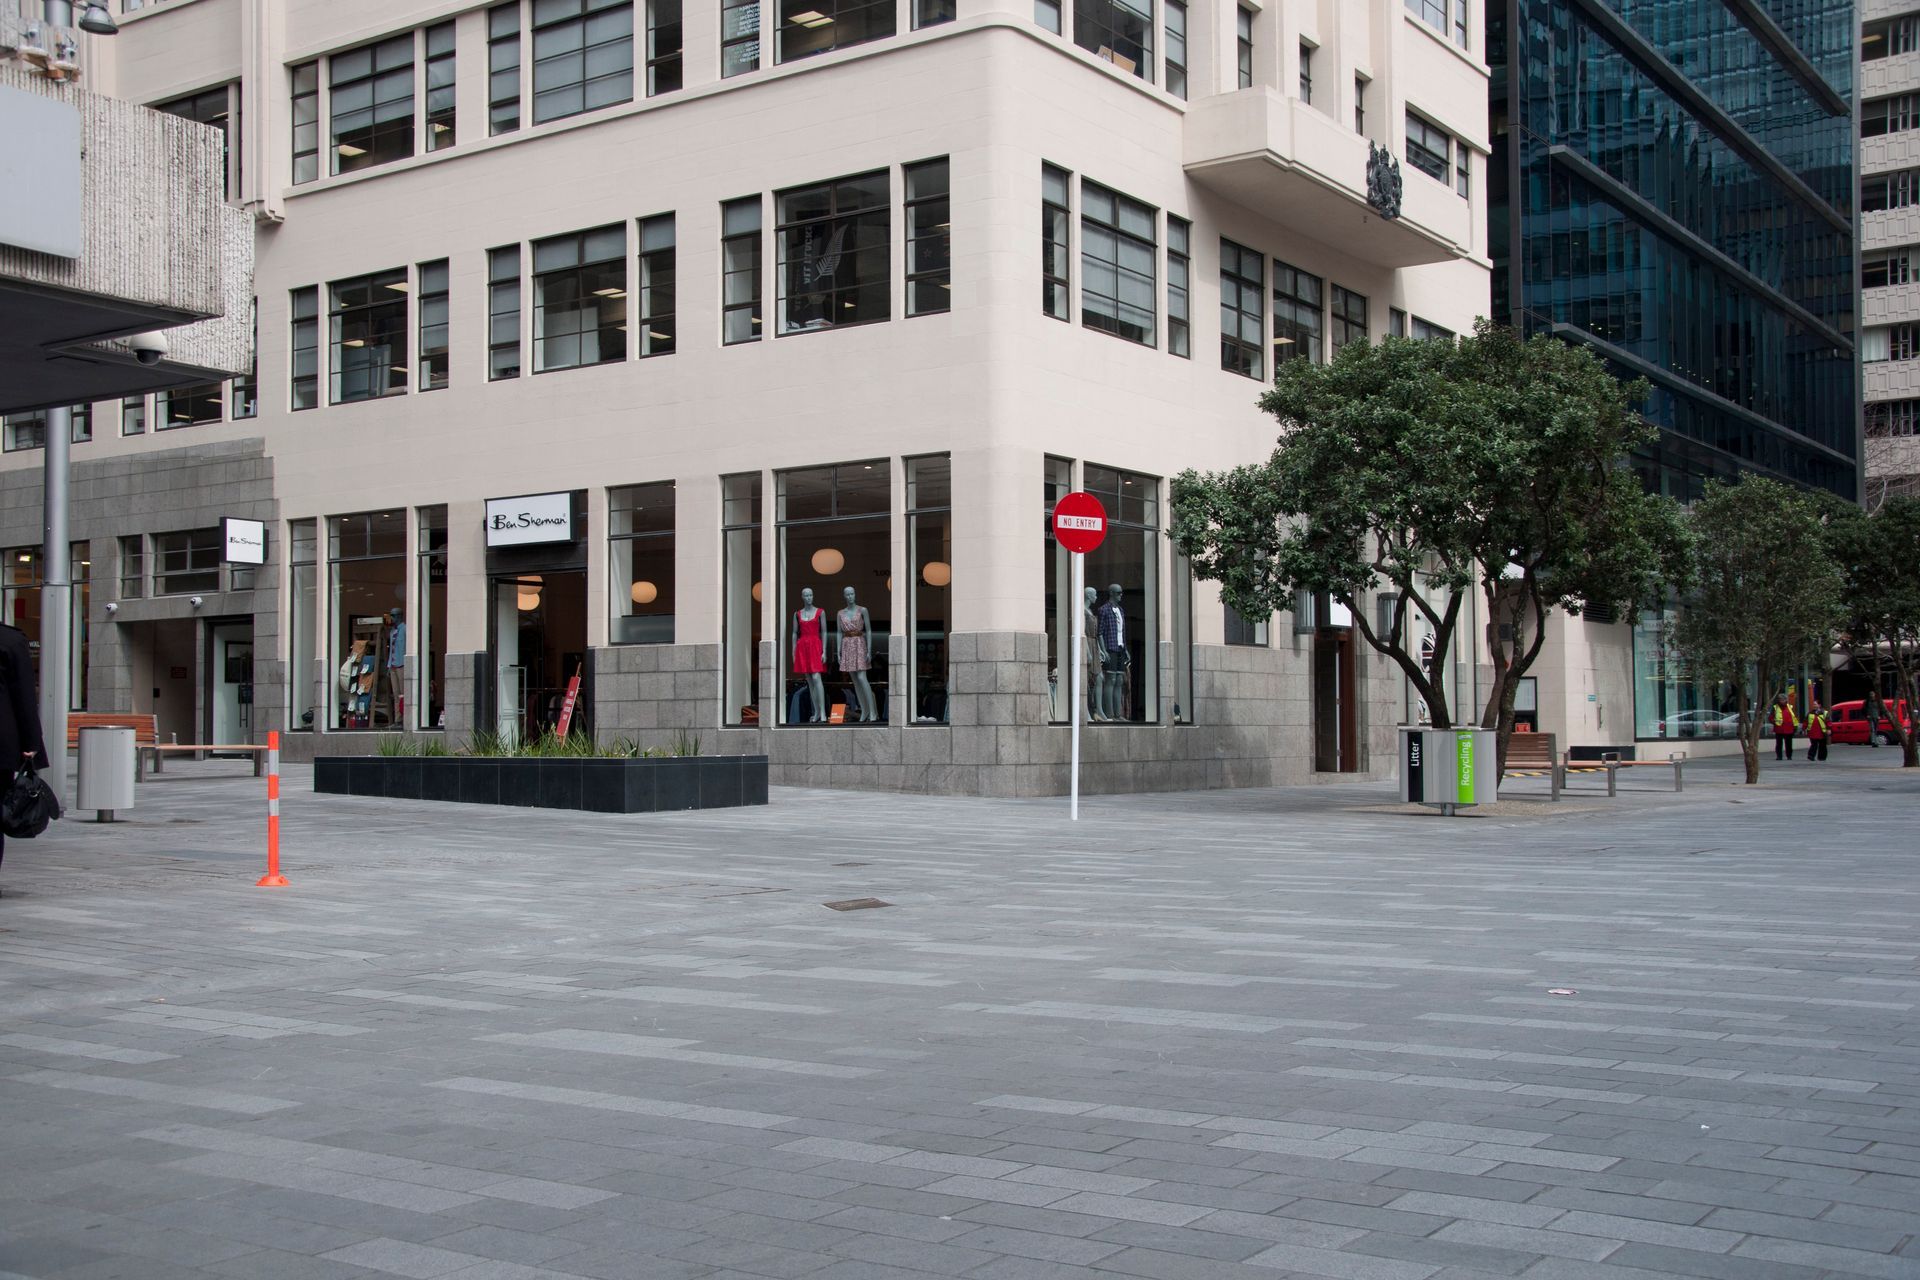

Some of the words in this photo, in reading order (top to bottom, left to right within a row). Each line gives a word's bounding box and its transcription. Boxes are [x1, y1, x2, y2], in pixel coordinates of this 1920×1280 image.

[490, 514, 517, 530] Ben
[517, 512, 567, 528] Sherman
[1063, 517, 1072, 527] NO
[1076, 518, 1096, 529] ENTRY
[1410, 741, 1420, 767] Litter
[1460, 741, 1472, 786] Recycling
